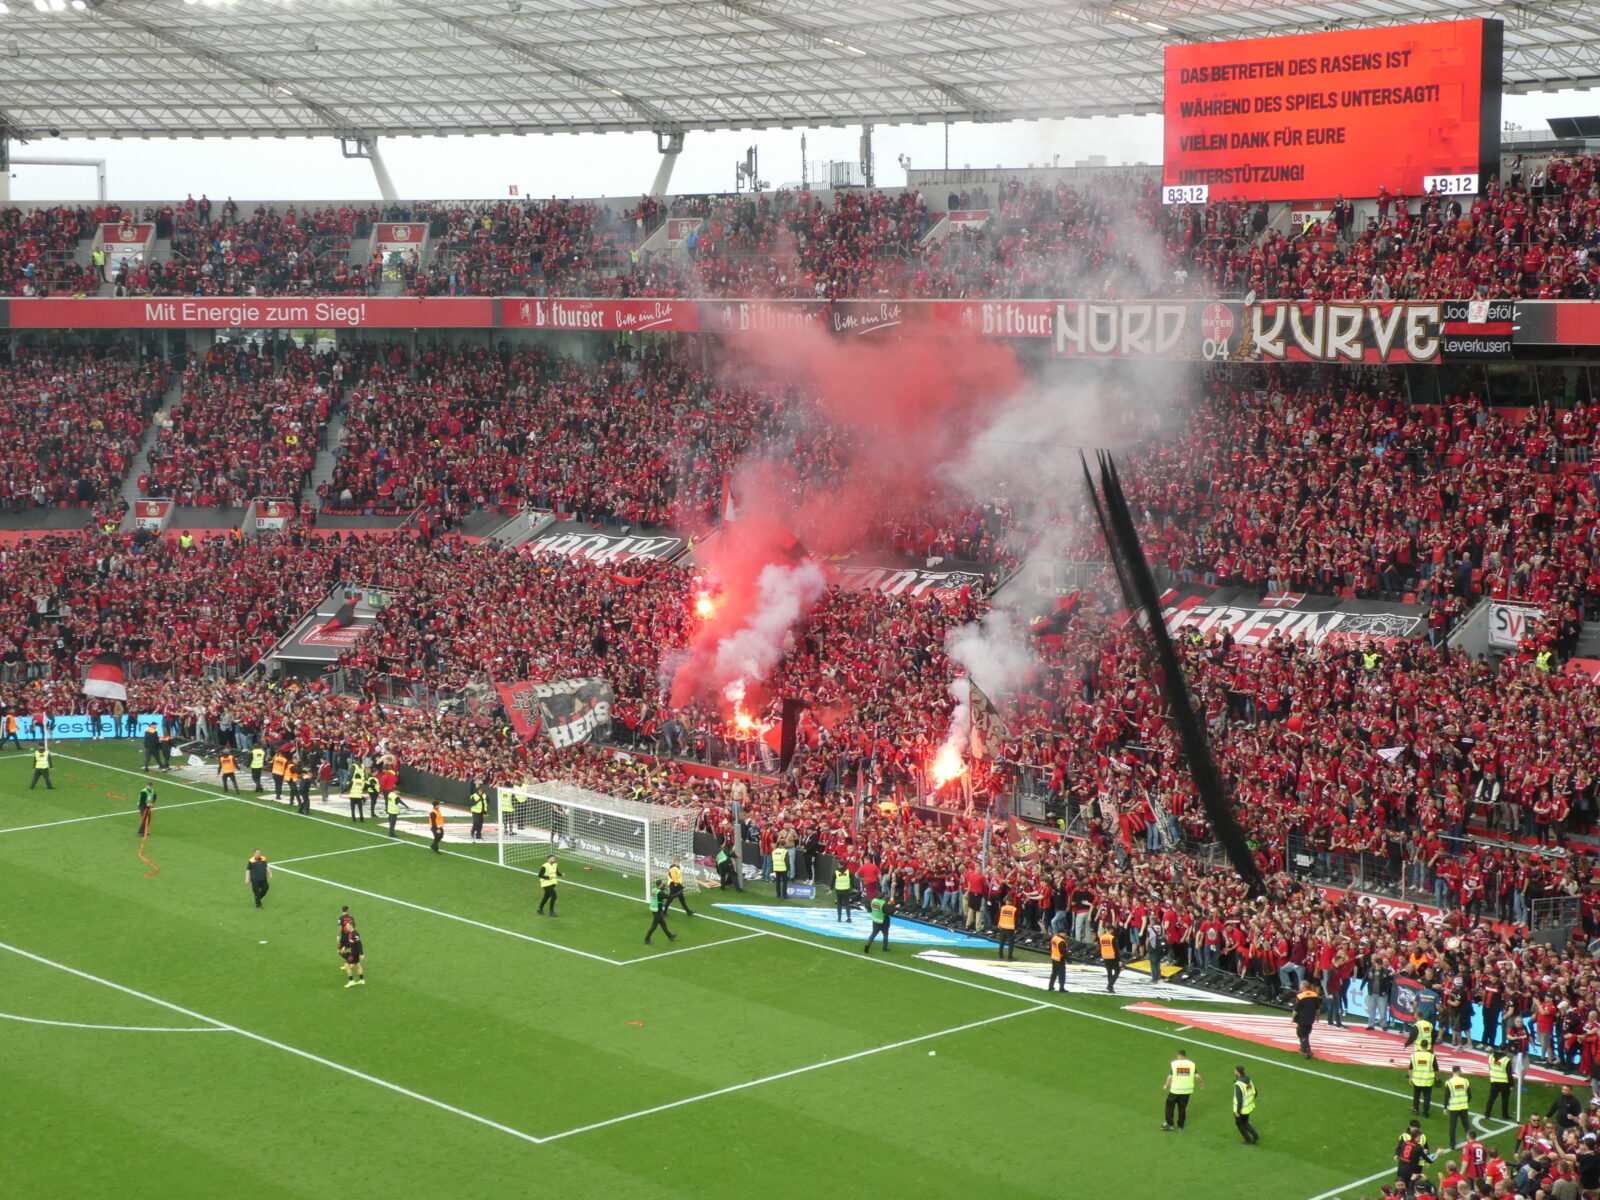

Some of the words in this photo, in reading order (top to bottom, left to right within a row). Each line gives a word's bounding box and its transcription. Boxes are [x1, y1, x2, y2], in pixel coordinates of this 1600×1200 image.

[1180, 67, 1208, 84] DAS
[1211, 61, 1284, 82] BETRETEN
[1288, 58, 1317, 76] DES
[1320, 53, 1382, 73] RASENS
[1386, 50, 1411, 69] IST
[1180, 97, 1251, 118] WÄHREND
[1254, 96, 1282, 113] DES
[1285, 92, 1338, 111] SPIELS
[1341, 84, 1440, 108] UNTERSAGT!
[1180, 133, 1227, 151] VIELEN
[1231, 131, 1270, 149] DANK
[1273, 127, 1303, 146] FÜR
[1306, 127, 1346, 145] EURE
[1179, 163, 1304, 185] UNTERSTÜTZUNG!
[1432, 177, 1472, 192] 19:12
[1168, 187, 1203, 201] 83:12
[145, 303, 175, 321] Mit
[182, 303, 260, 325] Energie
[265, 307, 308, 321] zum
[315, 303, 366, 325] Sieg!
[1251, 303, 1440, 360] KURVE
[1202, 338, 1229, 360] 04
[1444, 338, 1511, 353] Leverkusen
[1475, 1148, 1484, 1162] 9
